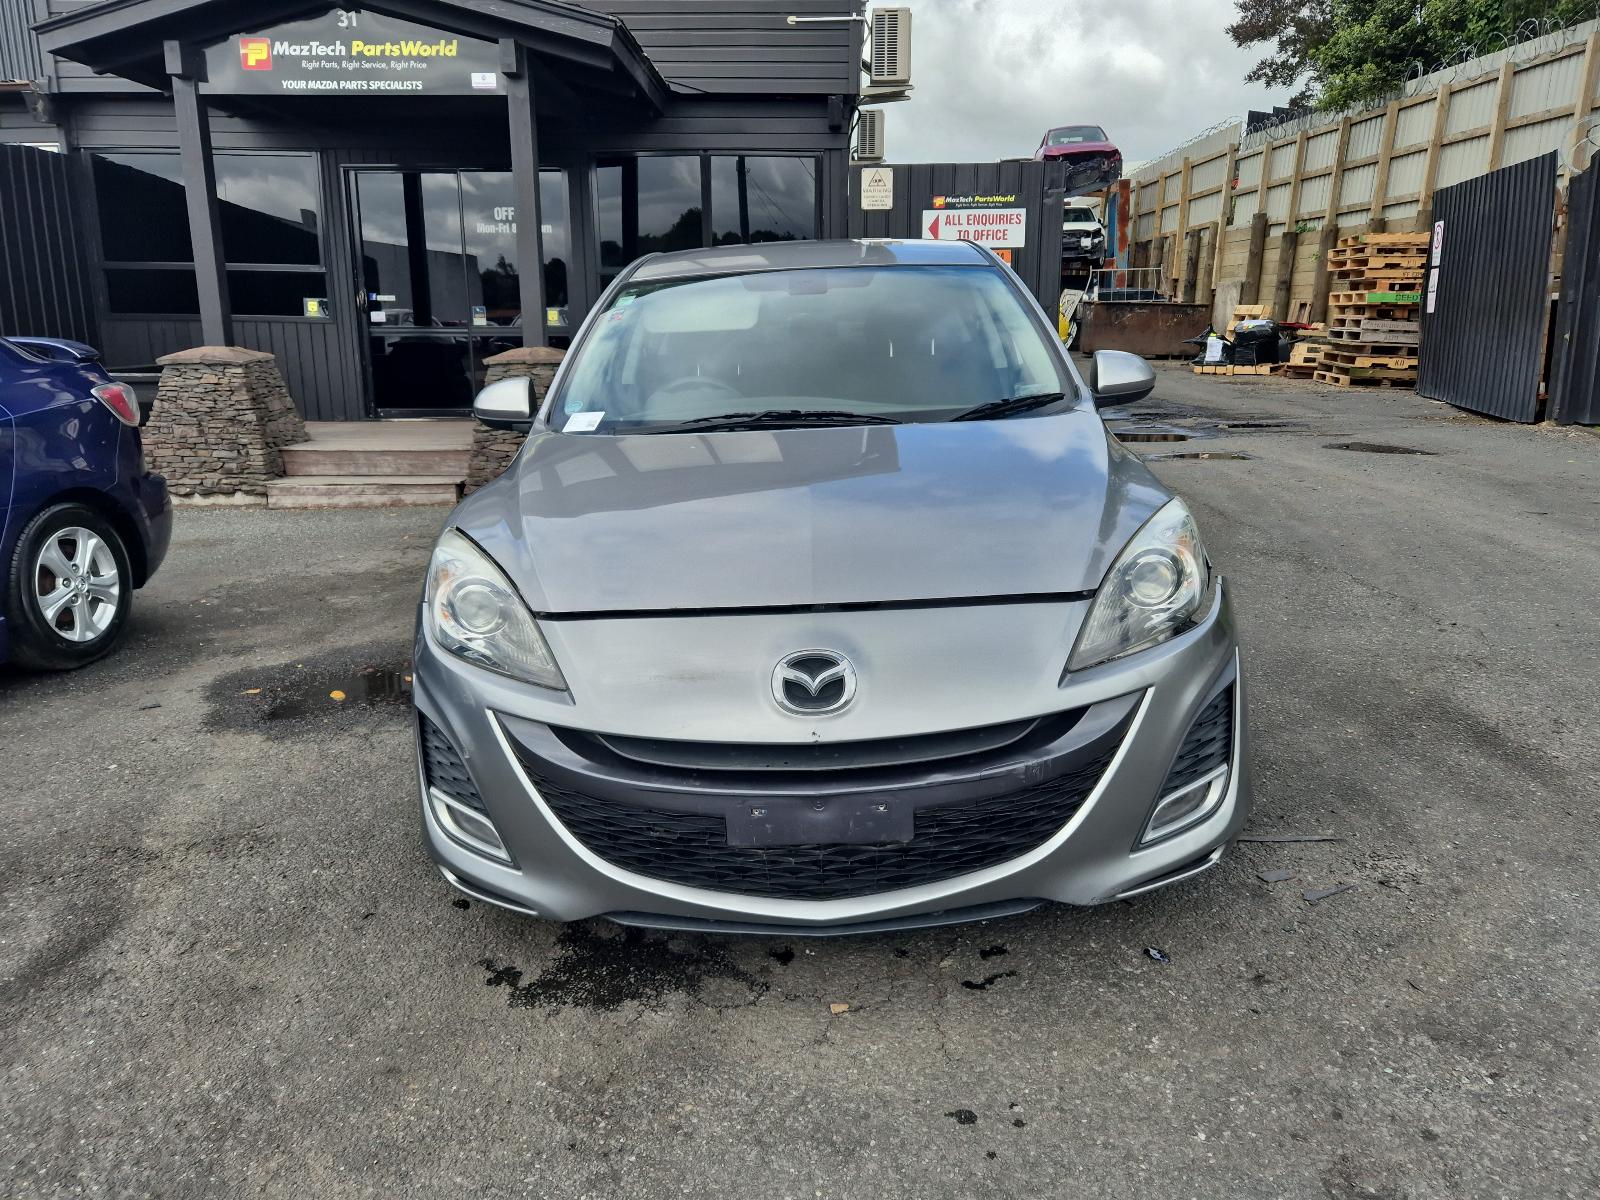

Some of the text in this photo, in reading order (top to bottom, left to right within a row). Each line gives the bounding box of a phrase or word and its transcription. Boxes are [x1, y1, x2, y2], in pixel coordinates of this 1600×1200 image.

[337, 10, 357, 27] 31
[273, 39, 458, 57] MazTech PartsWorld
[302, 60, 427, 70] Right Parts, Right Service, Right Price
[281, 80, 423, 90] YOUR MAZDA PARTS SPECIALISTS
[494, 206, 515, 220] OFF
[945, 213, 1022, 226] ALL ENQUIRIES
[476, 223, 510, 233] Mon-Fri
[958, 229, 1008, 241] TO OFFICE
